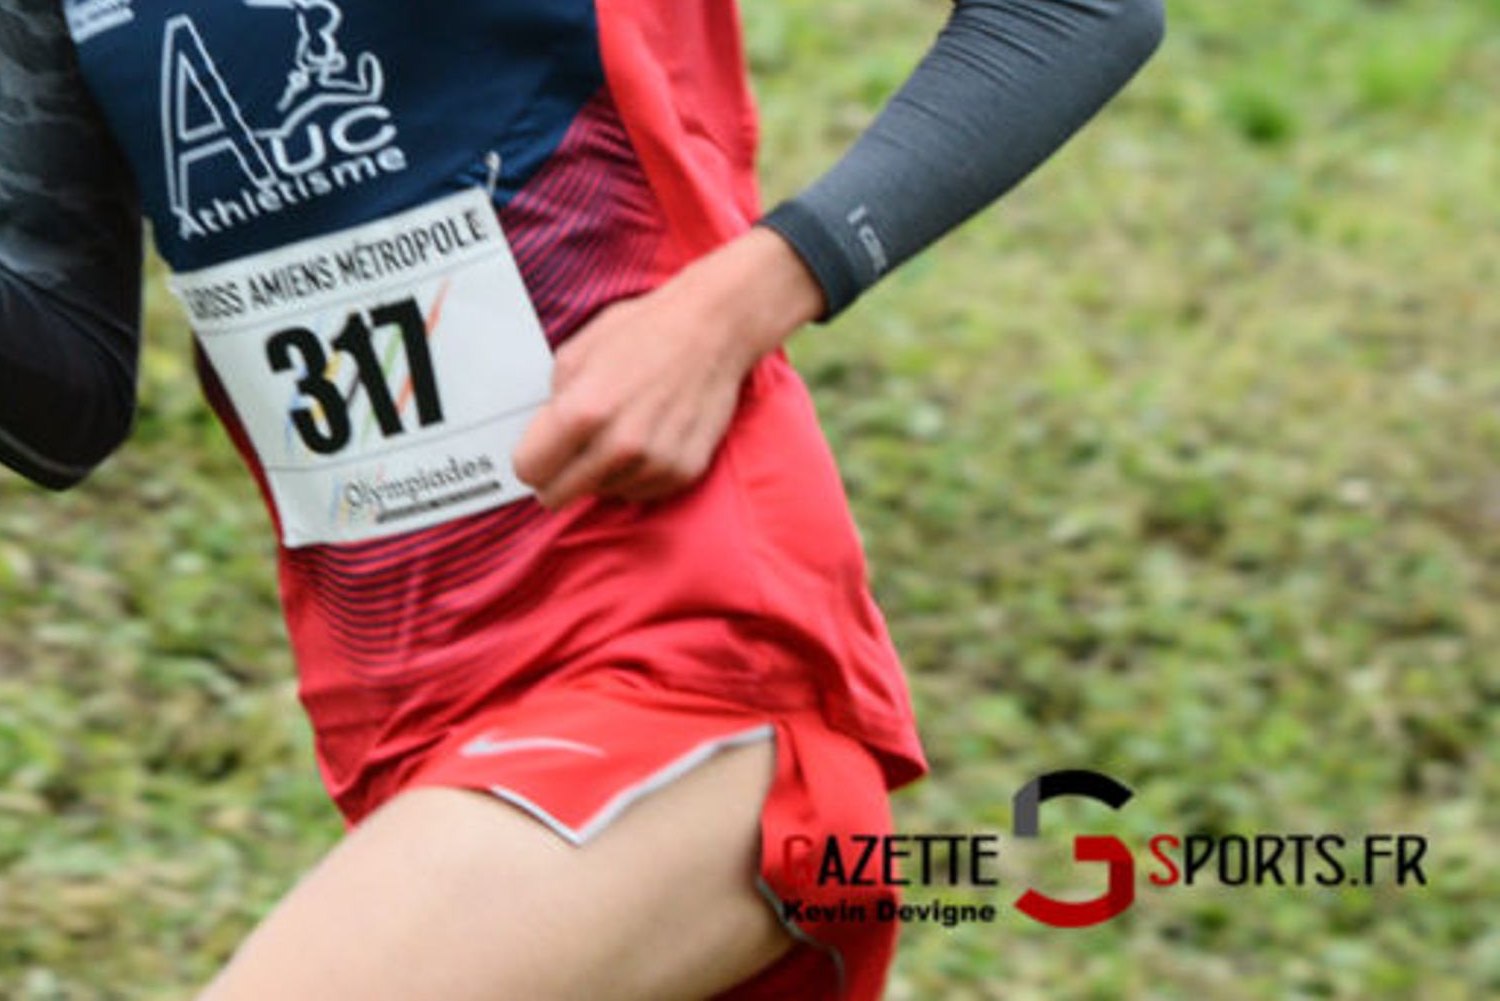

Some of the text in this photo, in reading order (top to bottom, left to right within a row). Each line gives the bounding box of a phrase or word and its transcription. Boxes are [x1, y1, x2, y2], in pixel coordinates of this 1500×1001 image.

[247, 255, 337, 309] AMIENS
[266, 296, 444, 455] 317
[345, 455, 494, 509] Olympiades
